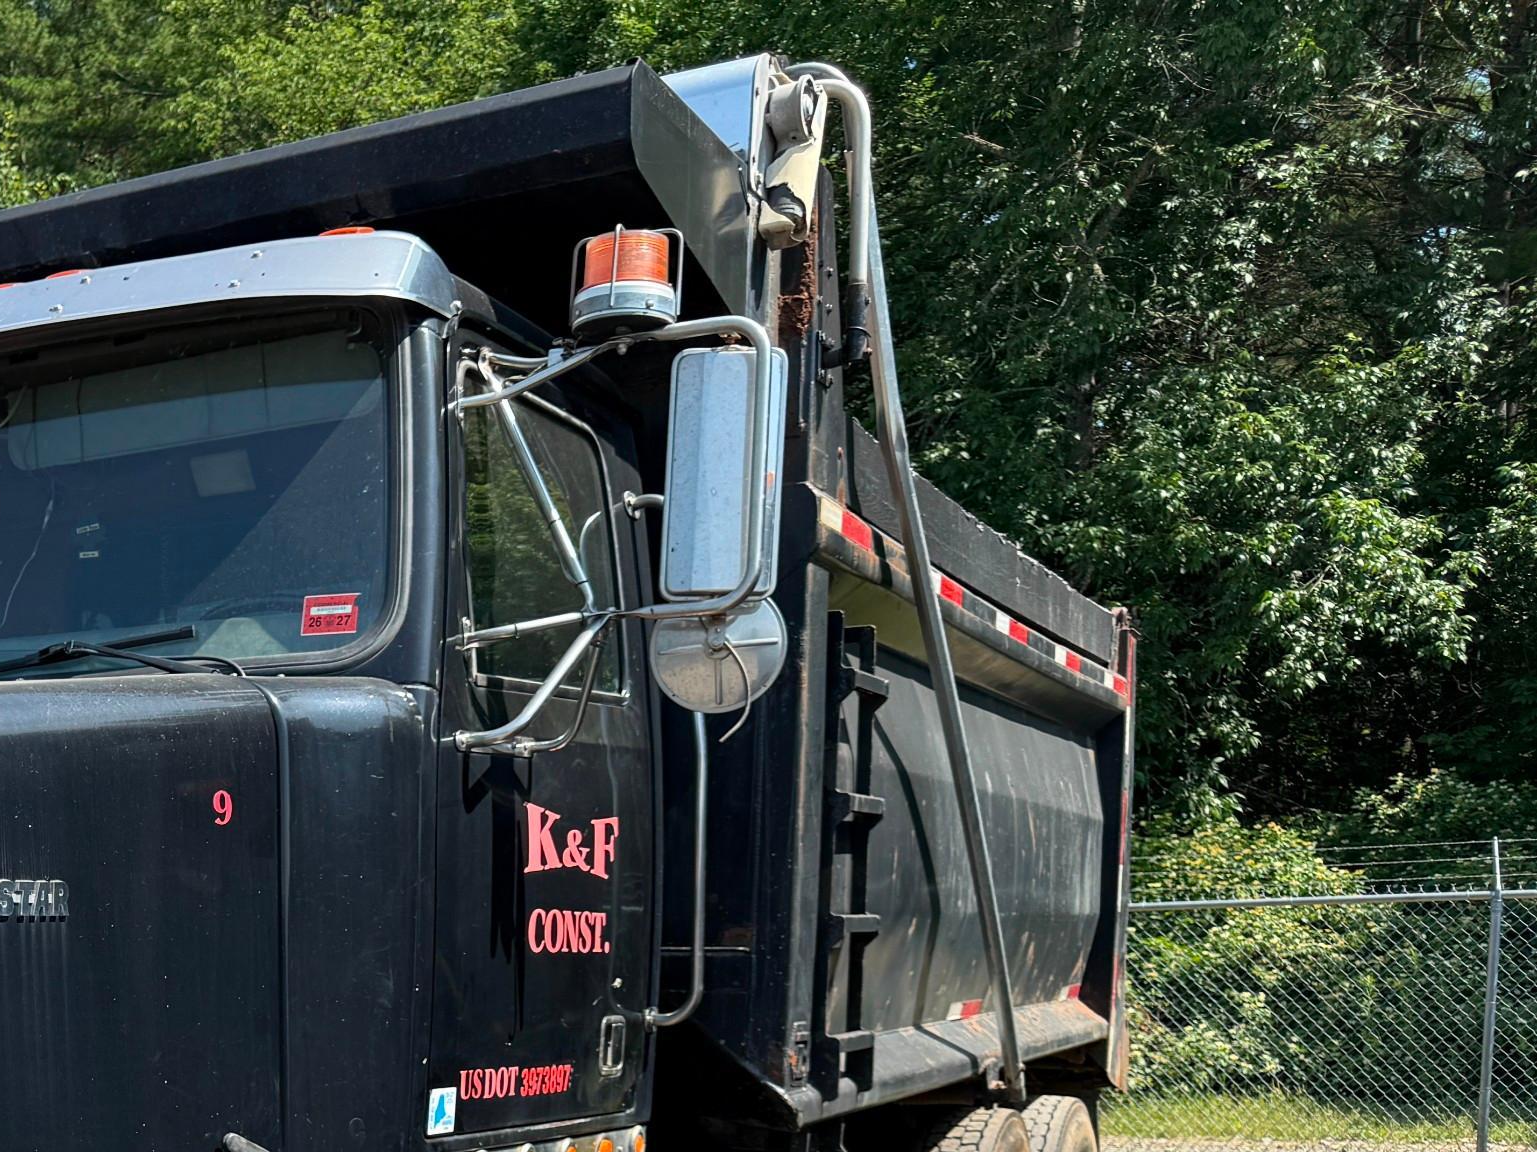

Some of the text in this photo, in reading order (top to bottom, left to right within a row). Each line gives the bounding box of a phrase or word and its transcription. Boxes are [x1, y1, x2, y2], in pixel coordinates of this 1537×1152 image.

[309, 615, 351, 627] 26 27
[212, 789, 233, 826] 9
[523, 802, 619, 879] K&F
[527, 908, 611, 954] CONST.
[460, 1064, 571, 1100] USDOT 3973897
